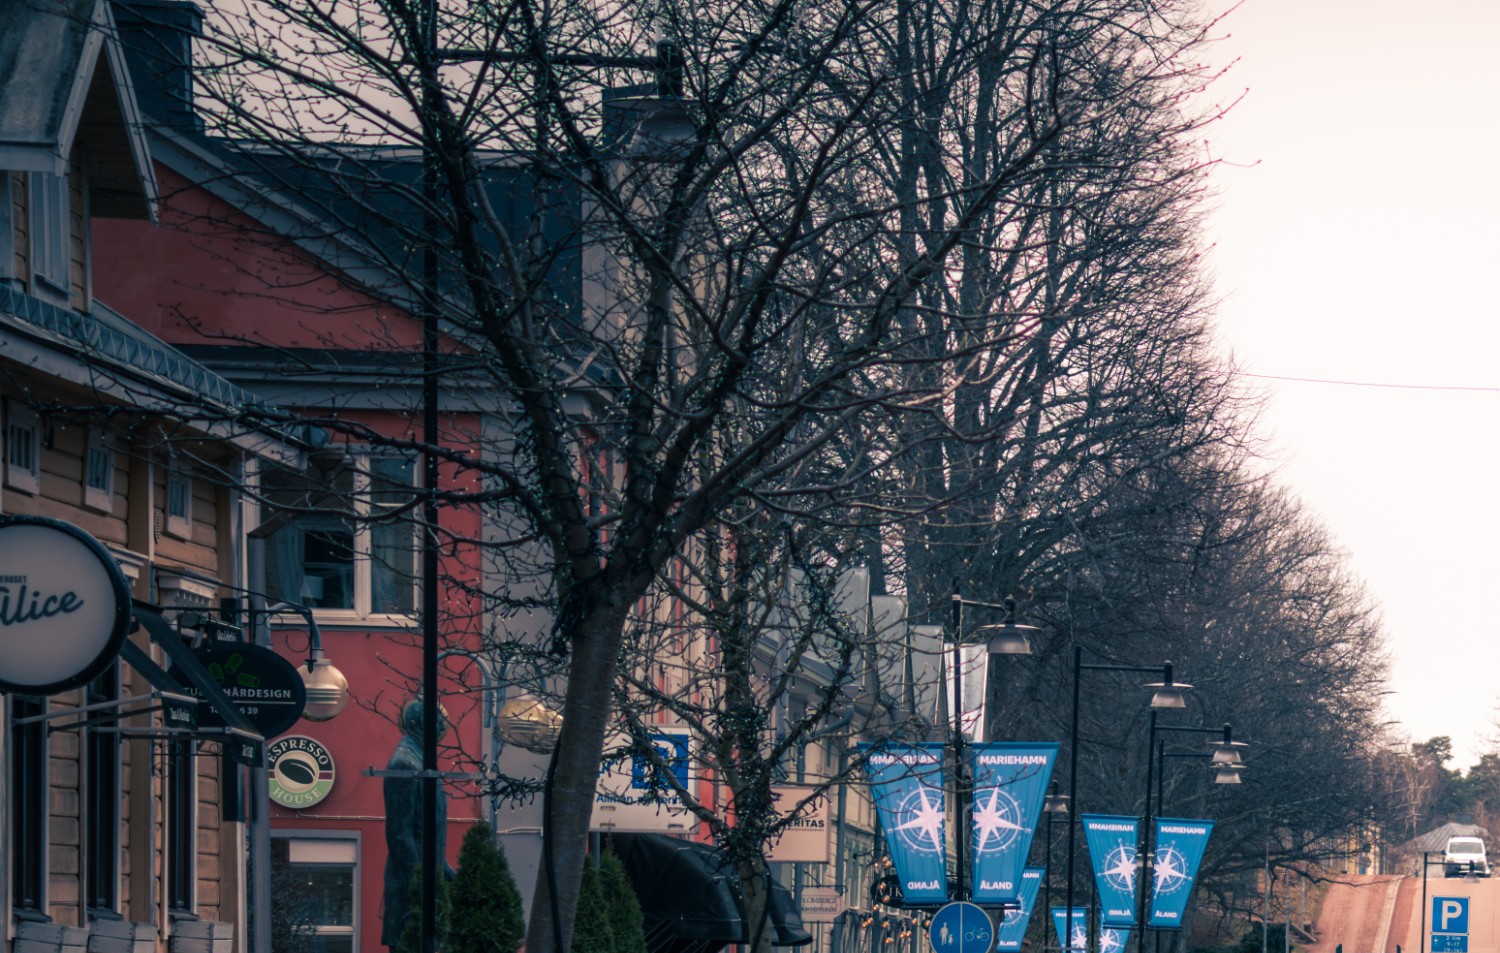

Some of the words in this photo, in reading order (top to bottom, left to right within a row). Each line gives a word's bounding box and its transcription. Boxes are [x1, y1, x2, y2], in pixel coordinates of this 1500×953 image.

[268, 739, 329, 765] ESPRESSO
[980, 755, 1047, 765] MARIEHAMN
[273, 786, 322, 805] HOUSE
[1161, 825, 1206, 834] MARIEHAMN
[980, 880, 1013, 890] ÅLAND
[1155, 910, 1178, 918] ÅLAND
[1441, 900, 1463, 930] P
